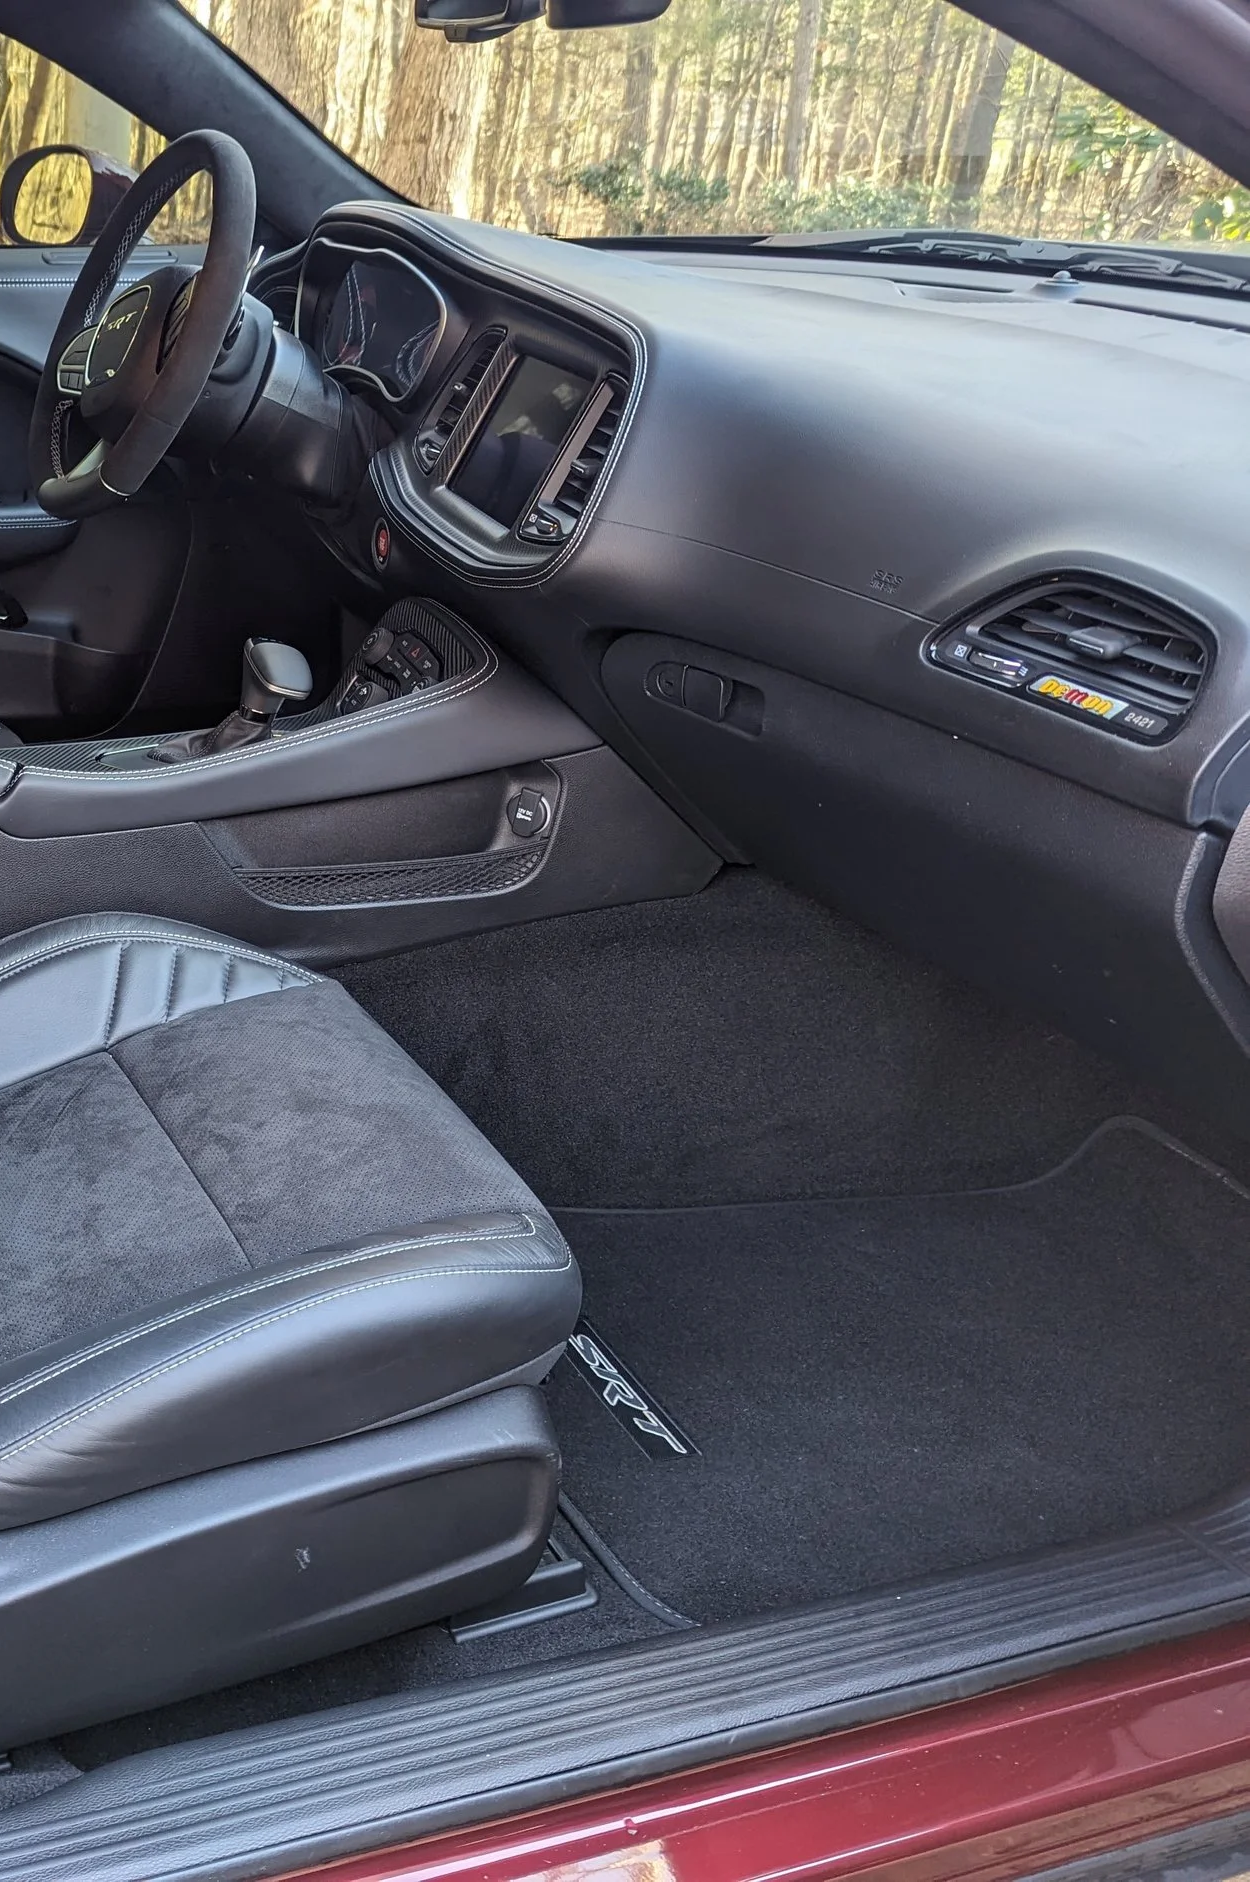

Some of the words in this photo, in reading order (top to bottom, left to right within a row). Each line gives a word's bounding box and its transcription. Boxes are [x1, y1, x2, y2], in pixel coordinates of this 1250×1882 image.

[107, 310, 138, 331] SRT
[1123, 712, 1156, 729] 2421
[567, 1333, 688, 1455] SRT
